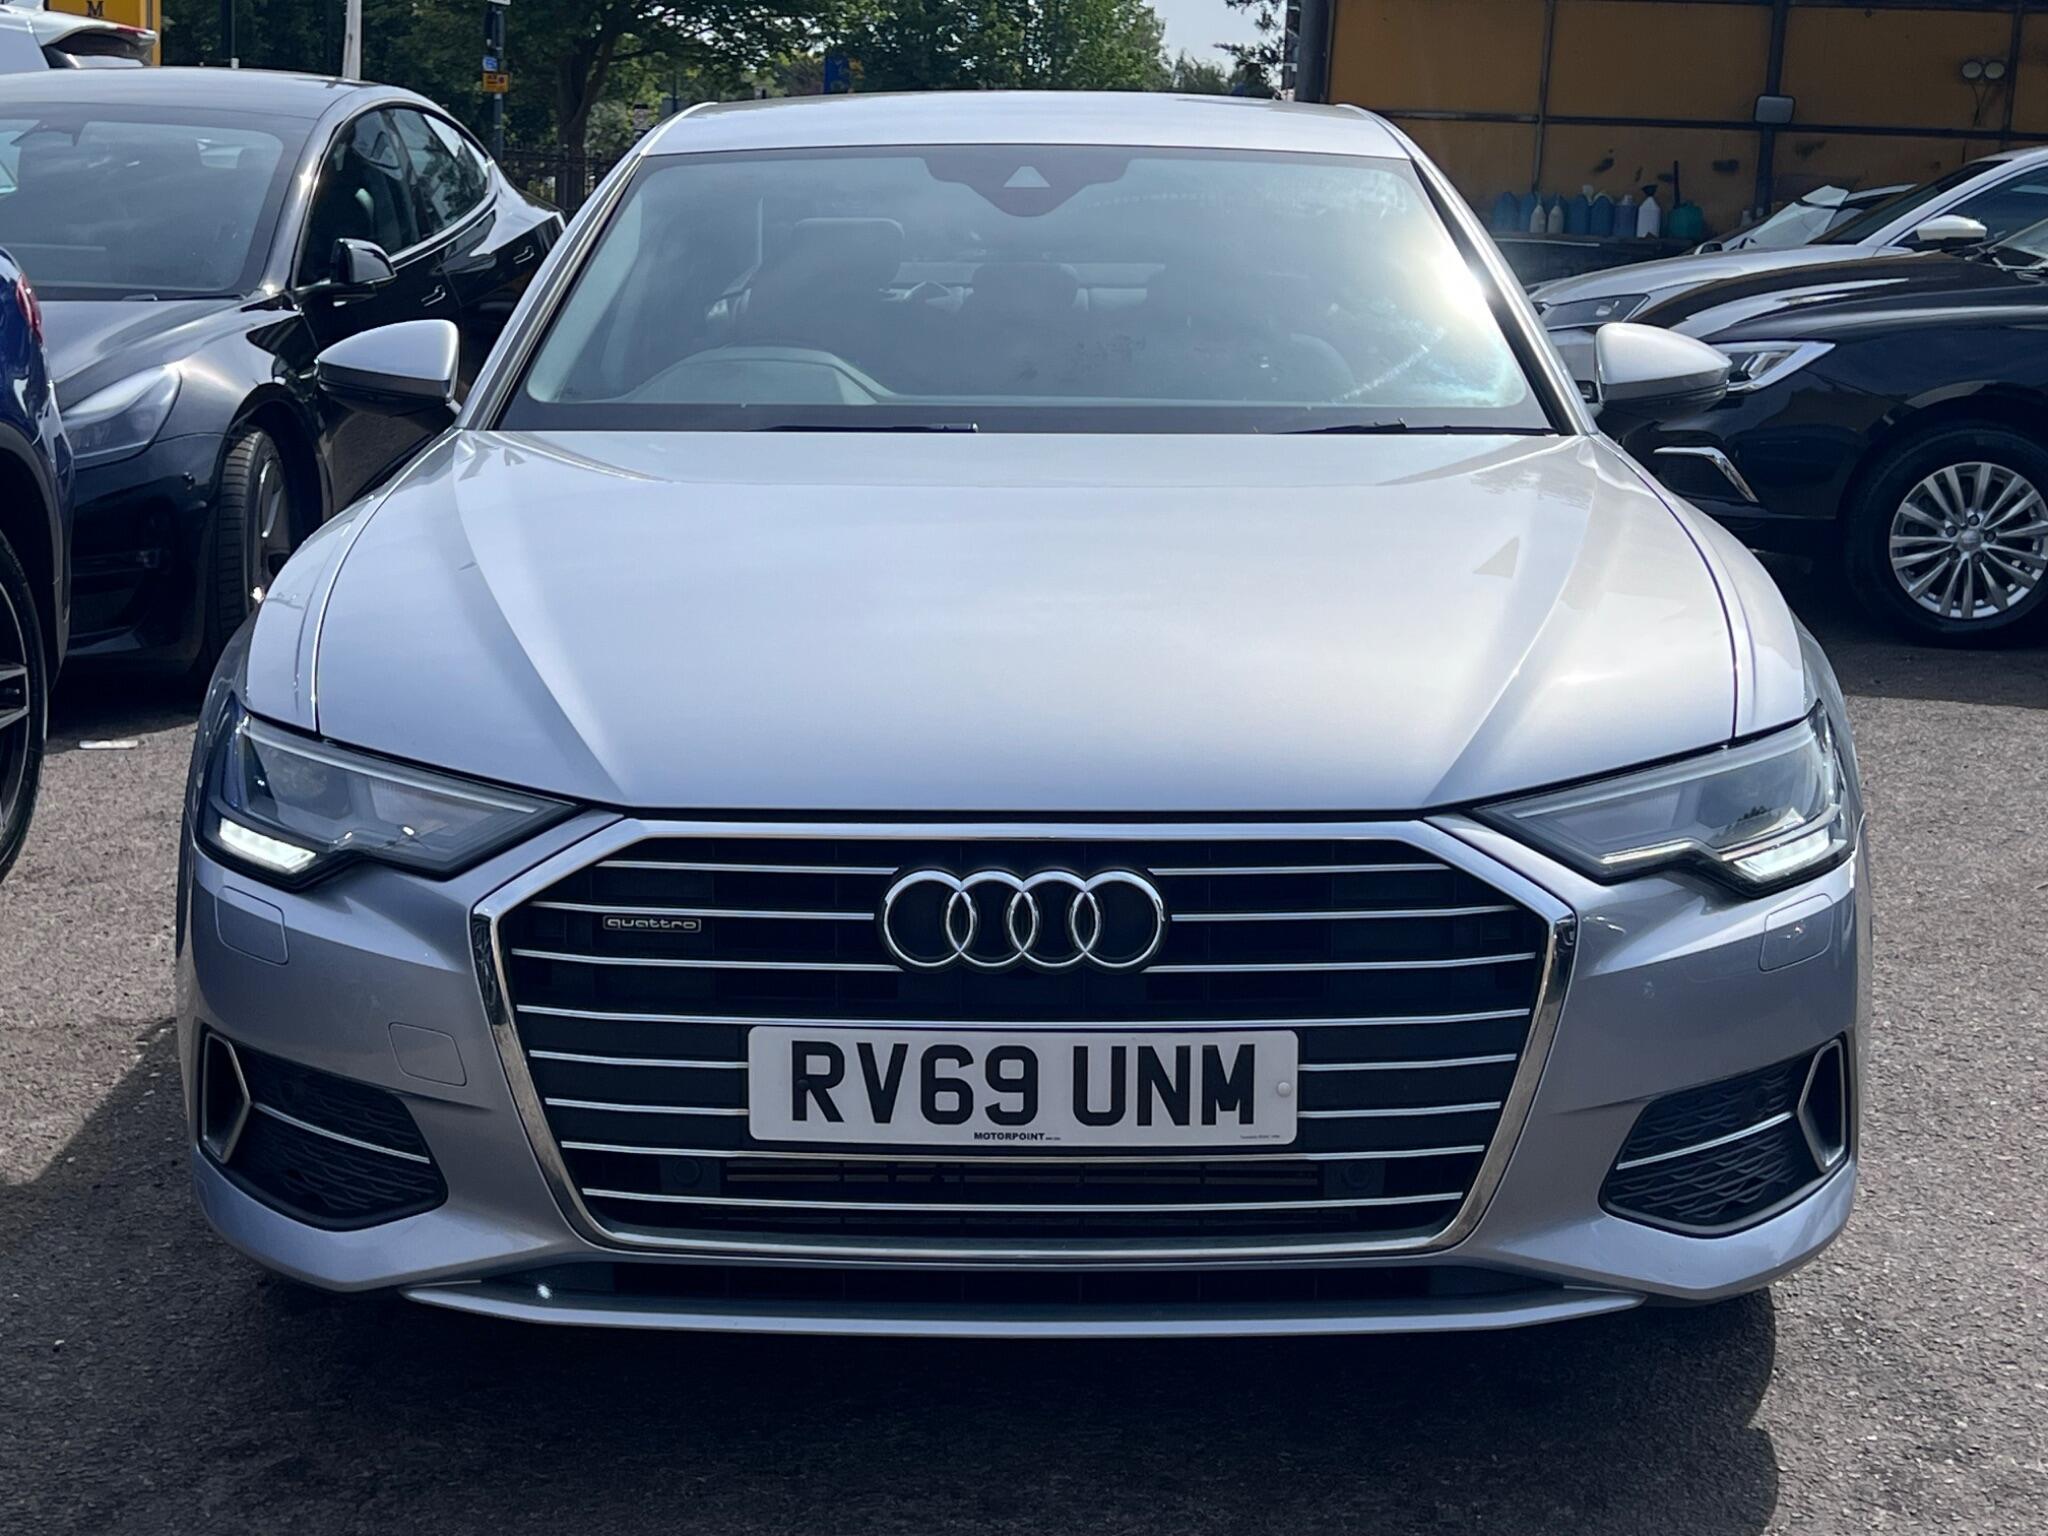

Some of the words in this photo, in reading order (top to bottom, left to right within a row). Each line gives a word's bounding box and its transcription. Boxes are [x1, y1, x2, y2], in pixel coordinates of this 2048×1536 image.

[607, 918, 697, 930] quattro
[791, 1040, 1039, 1126] RV69
[1073, 1043, 1255, 1126] UNM
[973, 1132, 1045, 1141] MOTORPOINT
